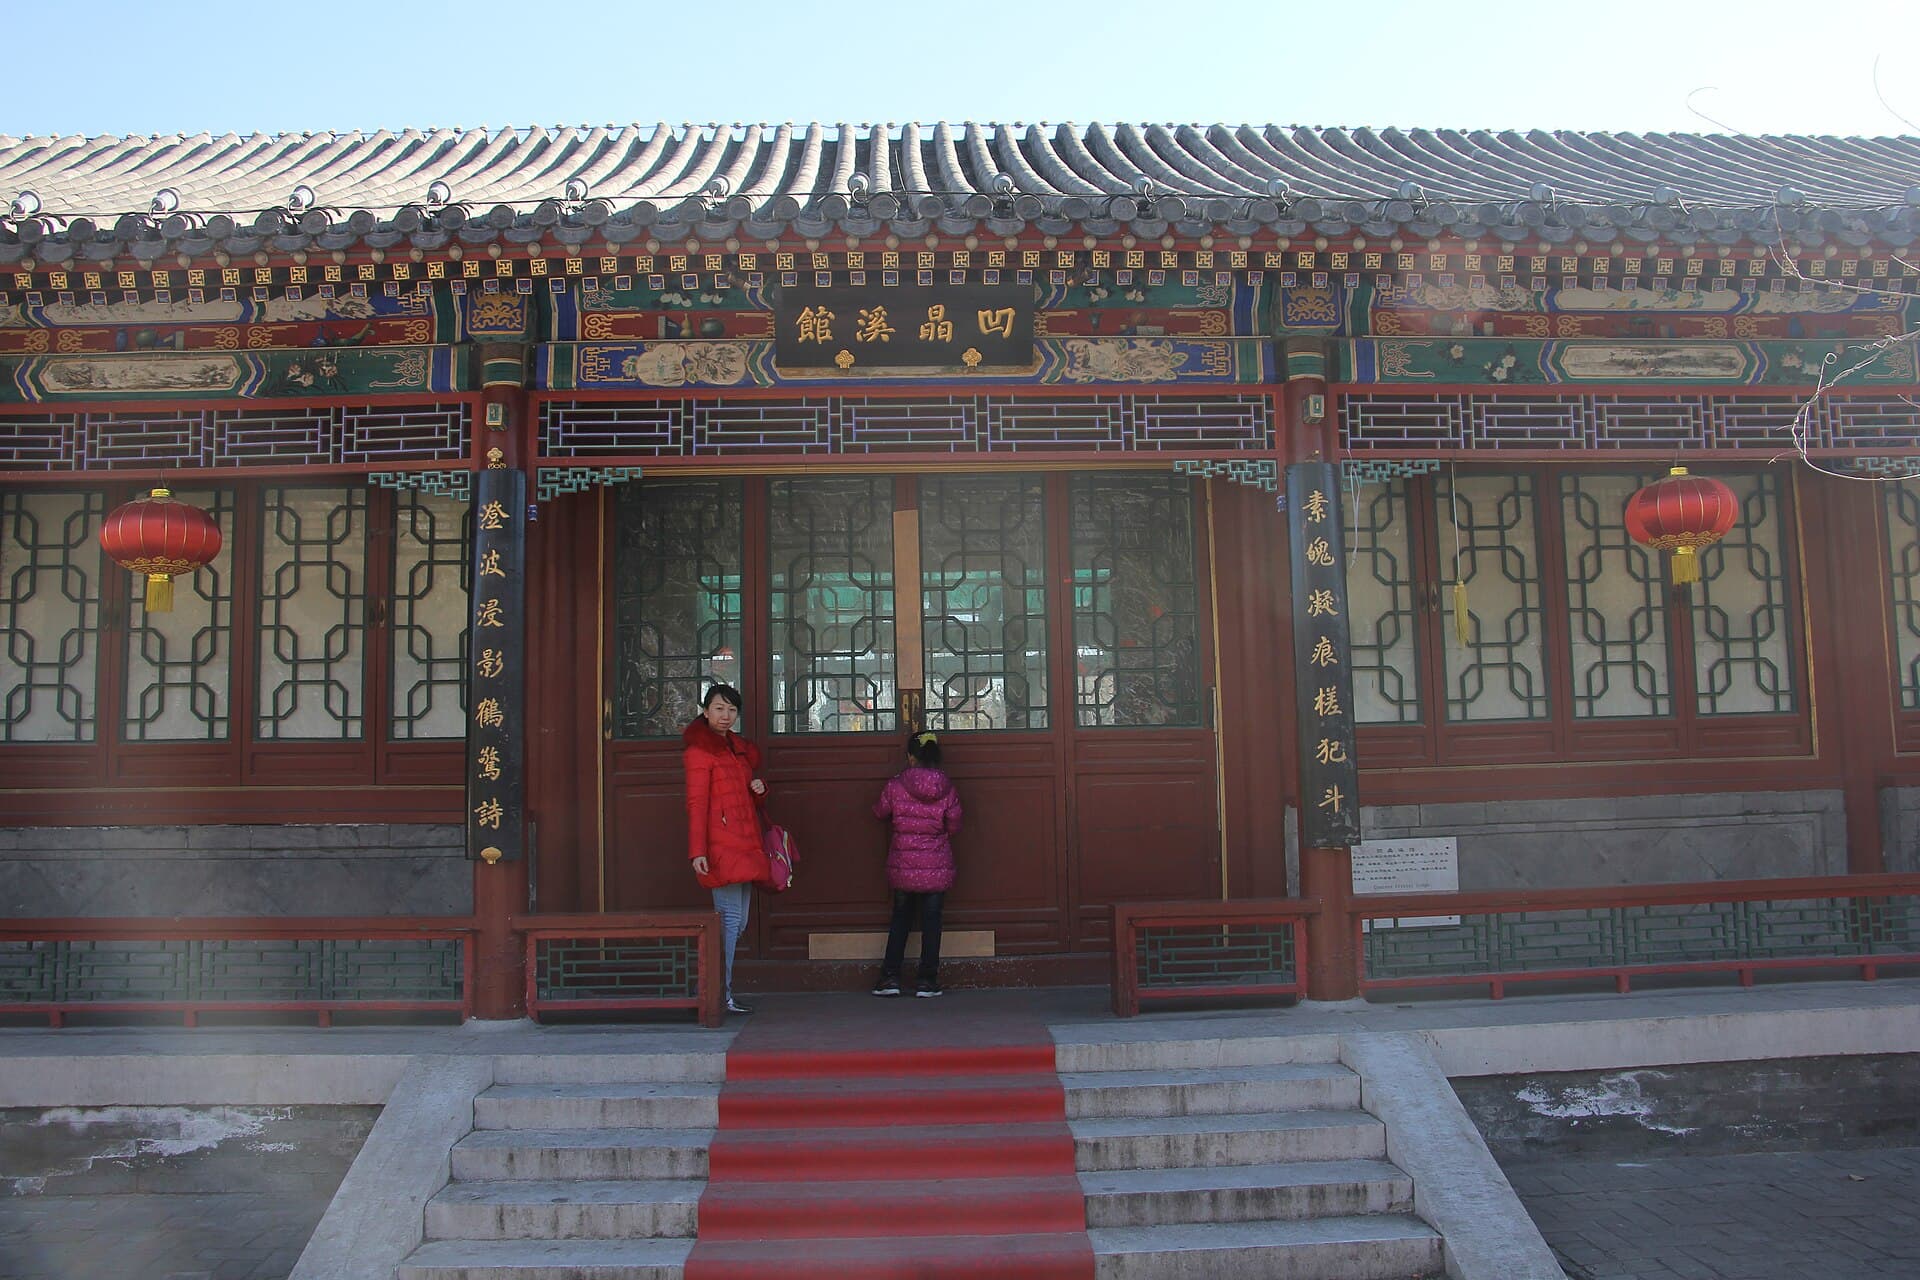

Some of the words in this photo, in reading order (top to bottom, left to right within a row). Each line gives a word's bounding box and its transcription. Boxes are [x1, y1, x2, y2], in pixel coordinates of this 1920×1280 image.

[474, 500, 510, 830] 澄波浸影鶴驚詩
[1302, 490, 1346, 813] 素魄凝痕槎犯斗
